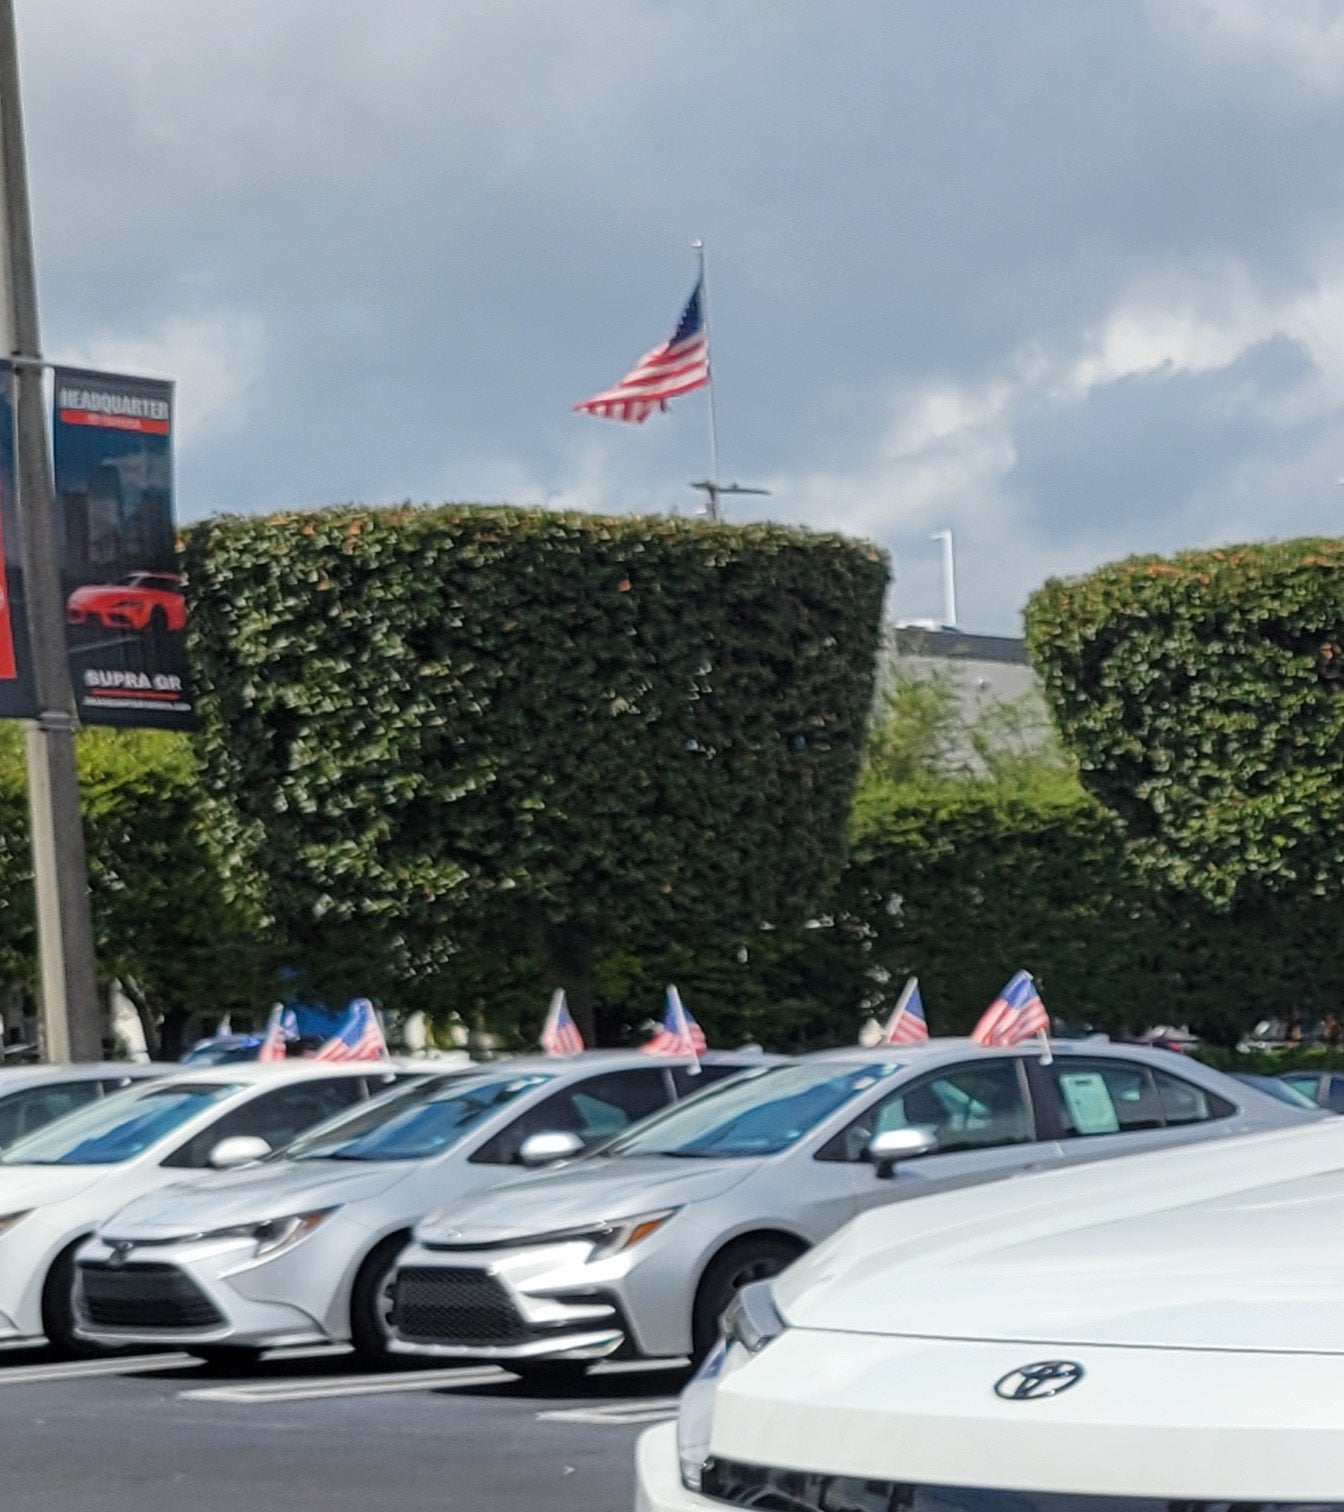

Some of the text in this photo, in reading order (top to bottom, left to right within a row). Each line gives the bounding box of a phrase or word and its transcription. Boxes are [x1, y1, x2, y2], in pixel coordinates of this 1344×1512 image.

[59, 387, 169, 420] HEADQUARTER
[84, 668, 183, 692] SUPRA GR
